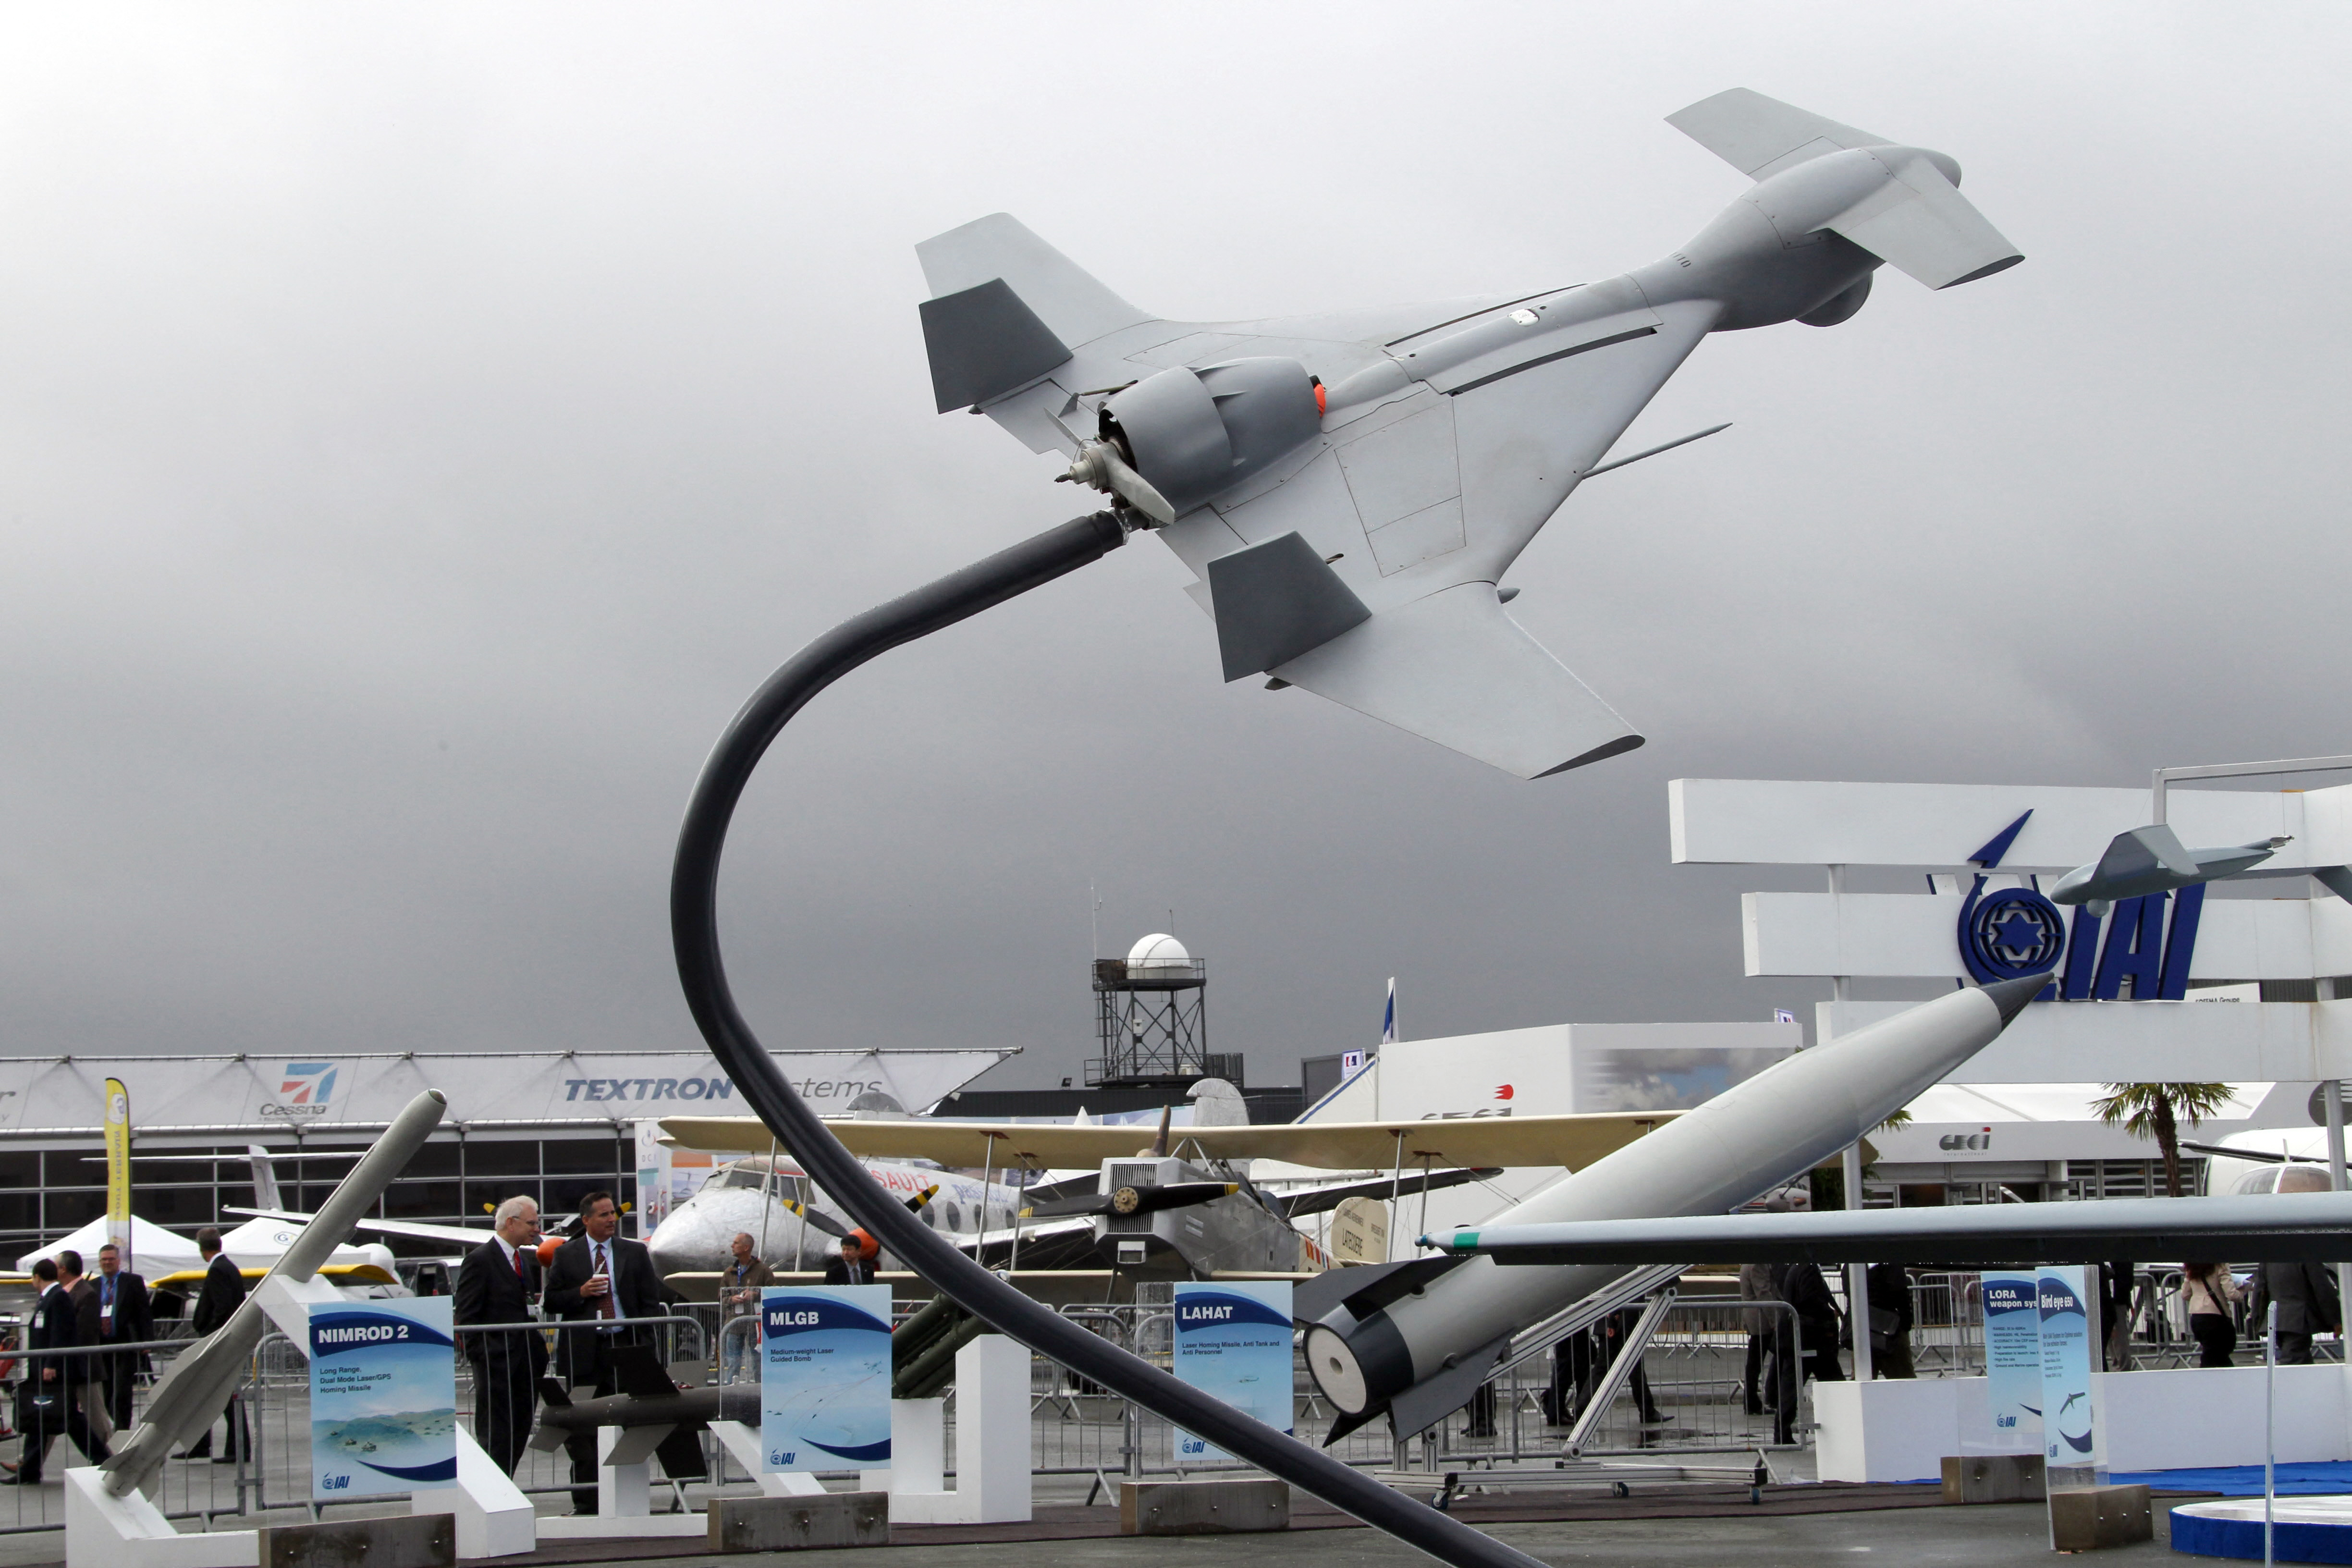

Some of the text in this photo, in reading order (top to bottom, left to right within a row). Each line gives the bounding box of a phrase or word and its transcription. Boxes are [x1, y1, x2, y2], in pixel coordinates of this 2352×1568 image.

[2060, 882, 2206, 1000] IAI
[564, 1078, 882, 1102] TEXTRON stems
[260, 1103, 327, 1116] Cessna
[870, 1170, 930, 1193] SAULT
[1989, 1290, 2017, 1299] LORA
[1990, 1300, 2022, 1309] weapon
[2041, 1294, 2073, 1311] Bird eye 650
[771, 1311, 819, 1325] MLGB
[1182, 1306, 1233, 1320] LAHAT
[318, 1325, 408, 1344] NIMROD 2
[357, 1373, 391, 1382] Laser/GPS
[2005, 1416, 2016, 1427] IAI
[1191, 1441, 1205, 1453] IAI
[781, 1452, 796, 1465] IAI
[333, 1476, 350, 1489] IAI
